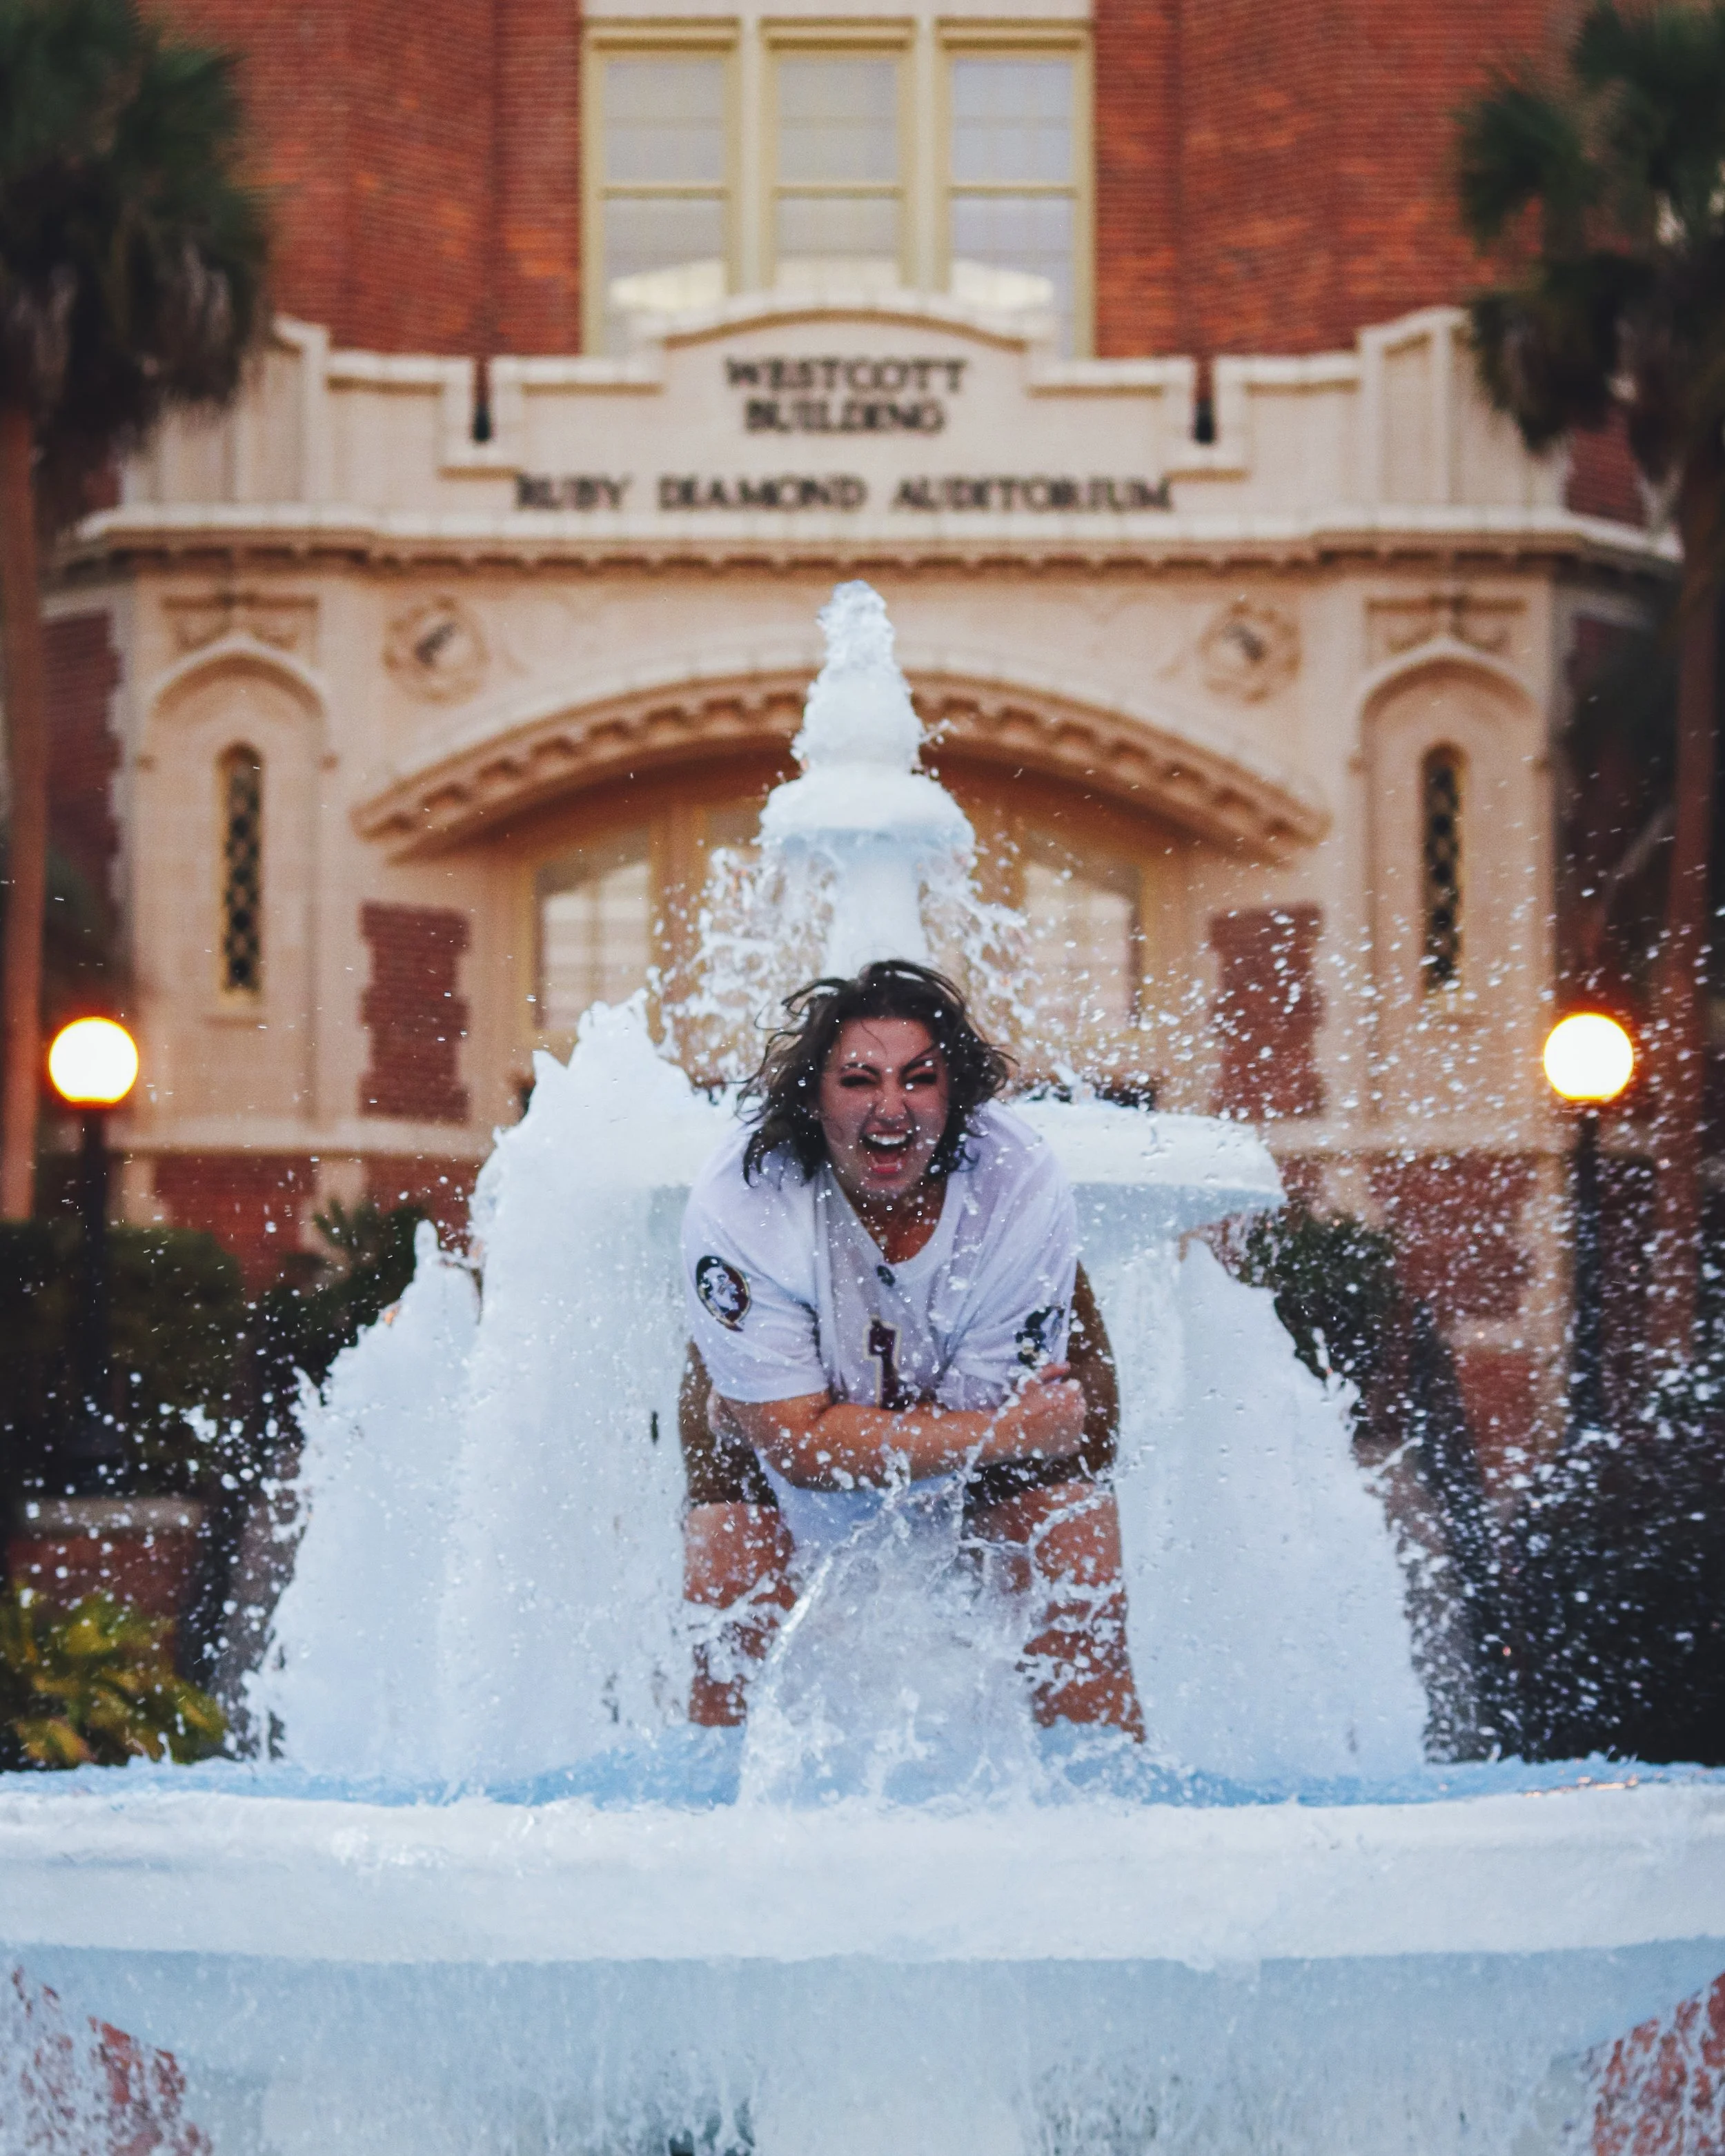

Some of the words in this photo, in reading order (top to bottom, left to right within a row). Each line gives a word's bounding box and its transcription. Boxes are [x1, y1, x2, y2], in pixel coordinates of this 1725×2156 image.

[726, 357, 967, 391] WESTCOTT
[745, 398, 945, 433] BUILDING
[515, 474, 629, 511] RUBY
[658, 475, 868, 511] DIAMOND
[891, 475, 1174, 511] AUDITORIUM
